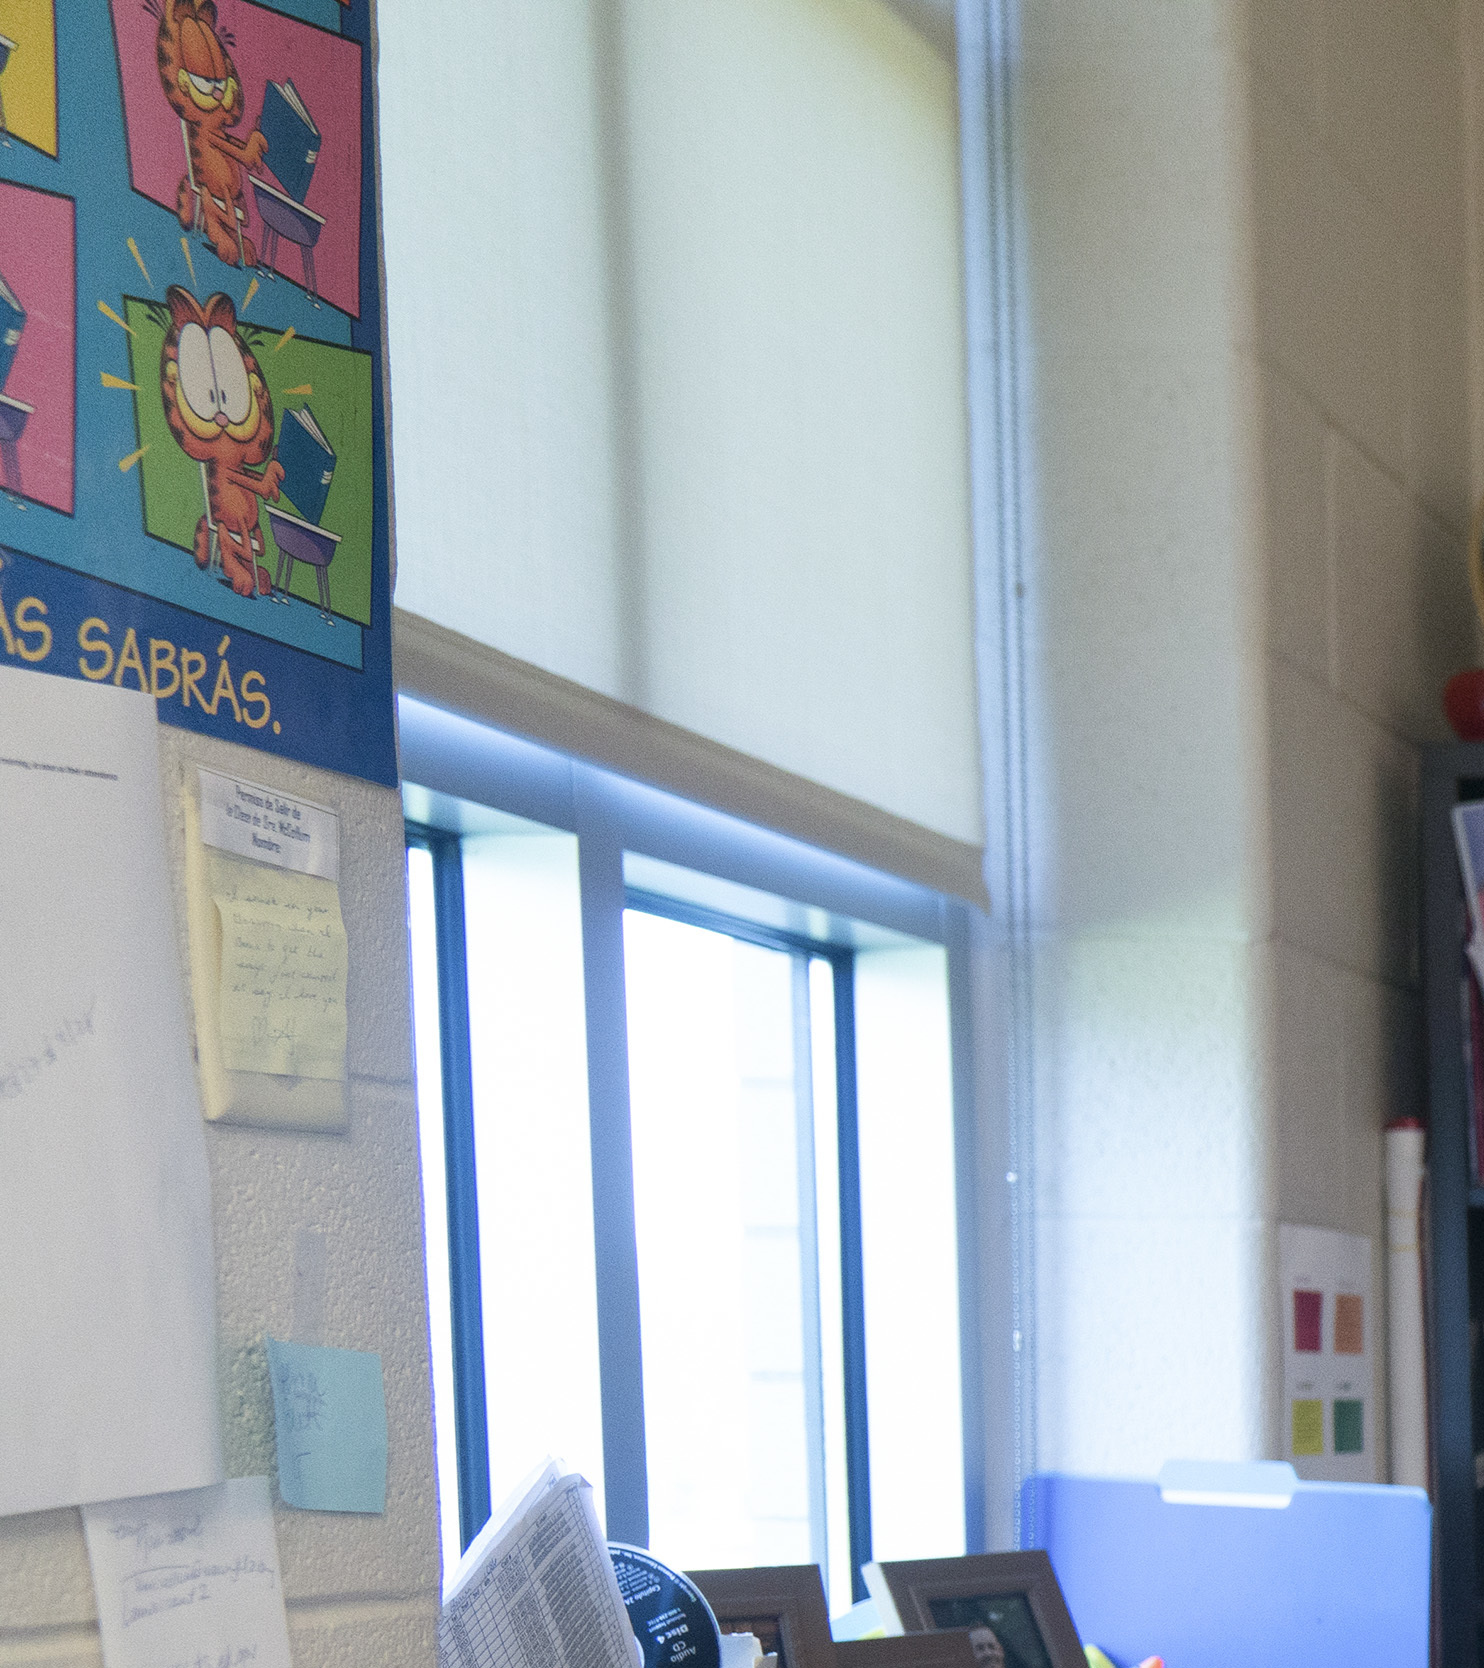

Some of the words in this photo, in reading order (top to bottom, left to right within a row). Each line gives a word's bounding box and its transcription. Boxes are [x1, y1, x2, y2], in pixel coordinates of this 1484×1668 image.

[78, 617, 281, 735] SABRÁS.
[655, 1634, 666, 1645] 4
[664, 1623, 690, 1640] Disc
[670, 1645, 697, 1664] Audio
[672, 1640, 687, 1653] CD
